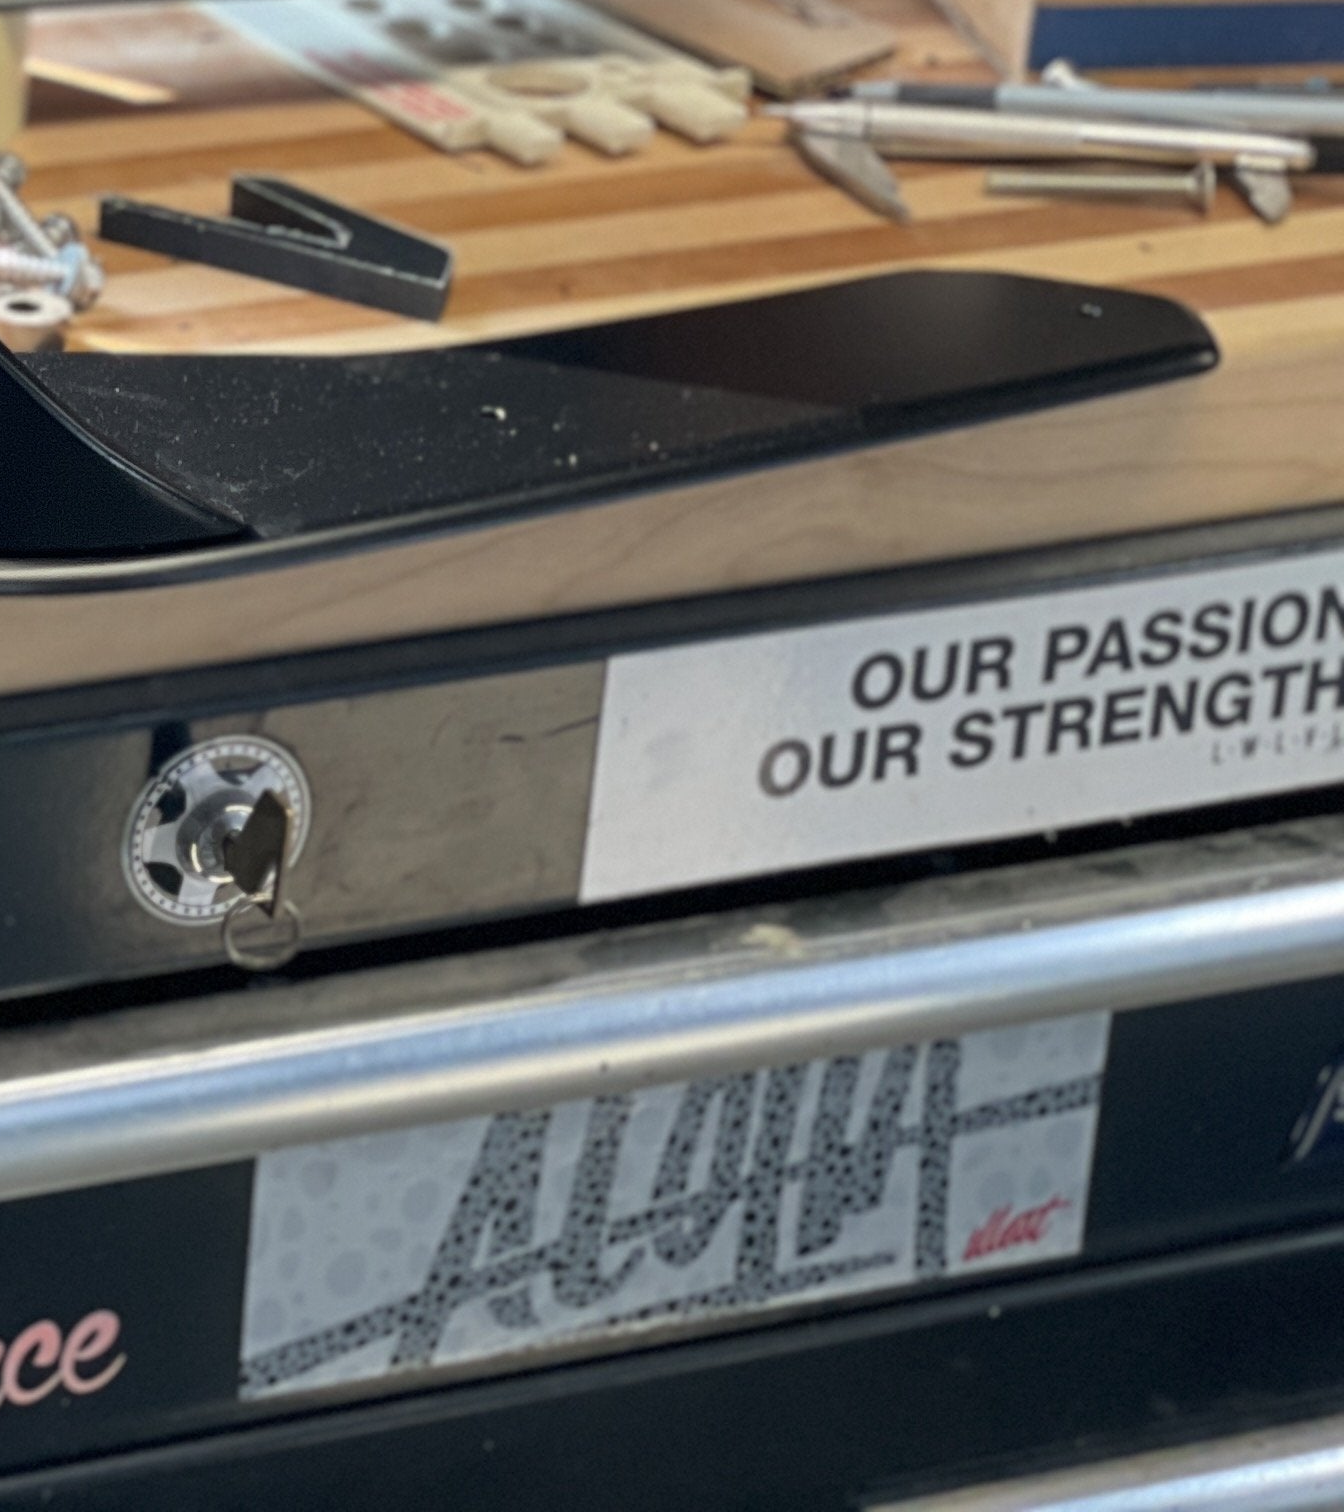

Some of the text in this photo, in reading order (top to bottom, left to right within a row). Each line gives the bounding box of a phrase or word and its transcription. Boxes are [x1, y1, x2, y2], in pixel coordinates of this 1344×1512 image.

[850, 585, 1344, 711] OUR PASSION
[757, 655, 1344, 798] OUR STRENGTH
